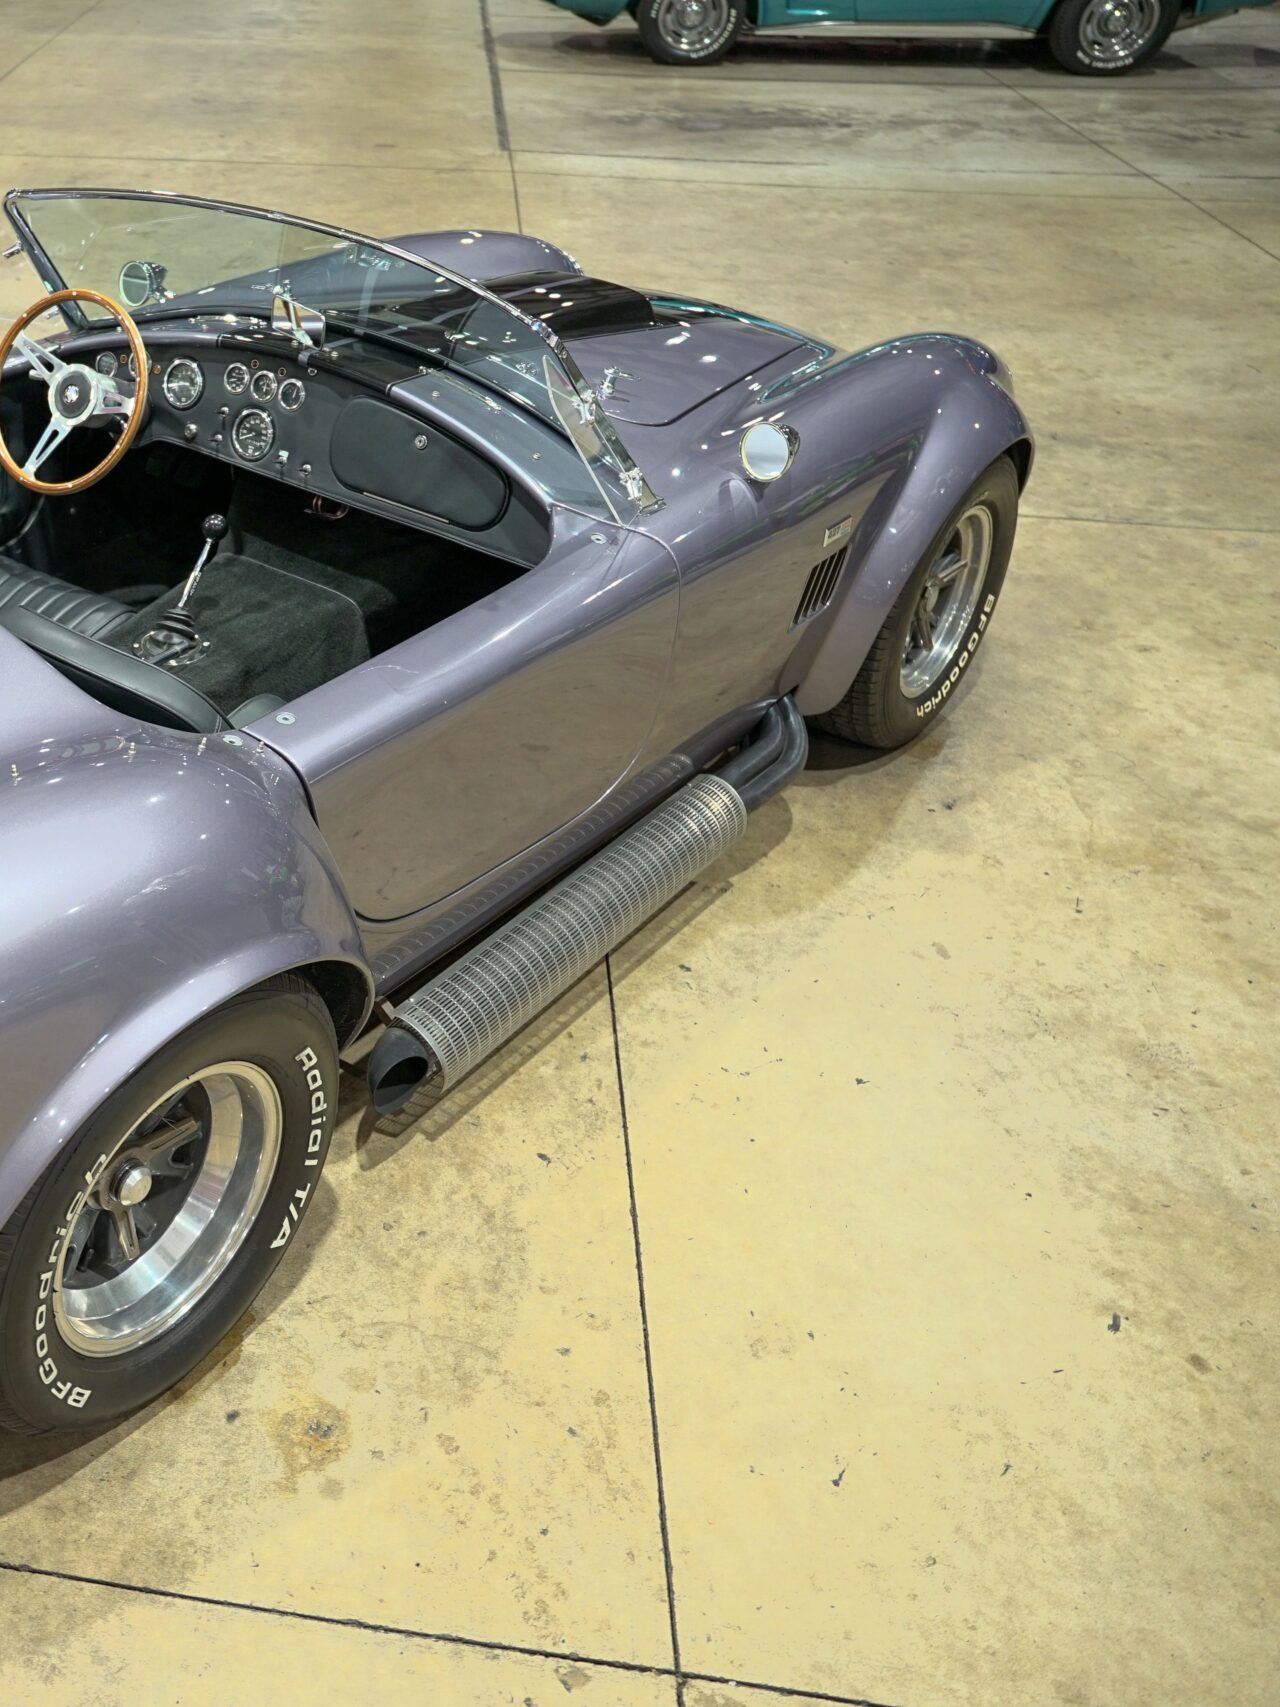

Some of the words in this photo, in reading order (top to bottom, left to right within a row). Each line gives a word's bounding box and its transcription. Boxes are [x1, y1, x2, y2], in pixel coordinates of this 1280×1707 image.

[916, 594, 995, 717] BFGoodrich
[295, 1047, 327, 1166] Radial
[270, 1183, 311, 1248] T/A
